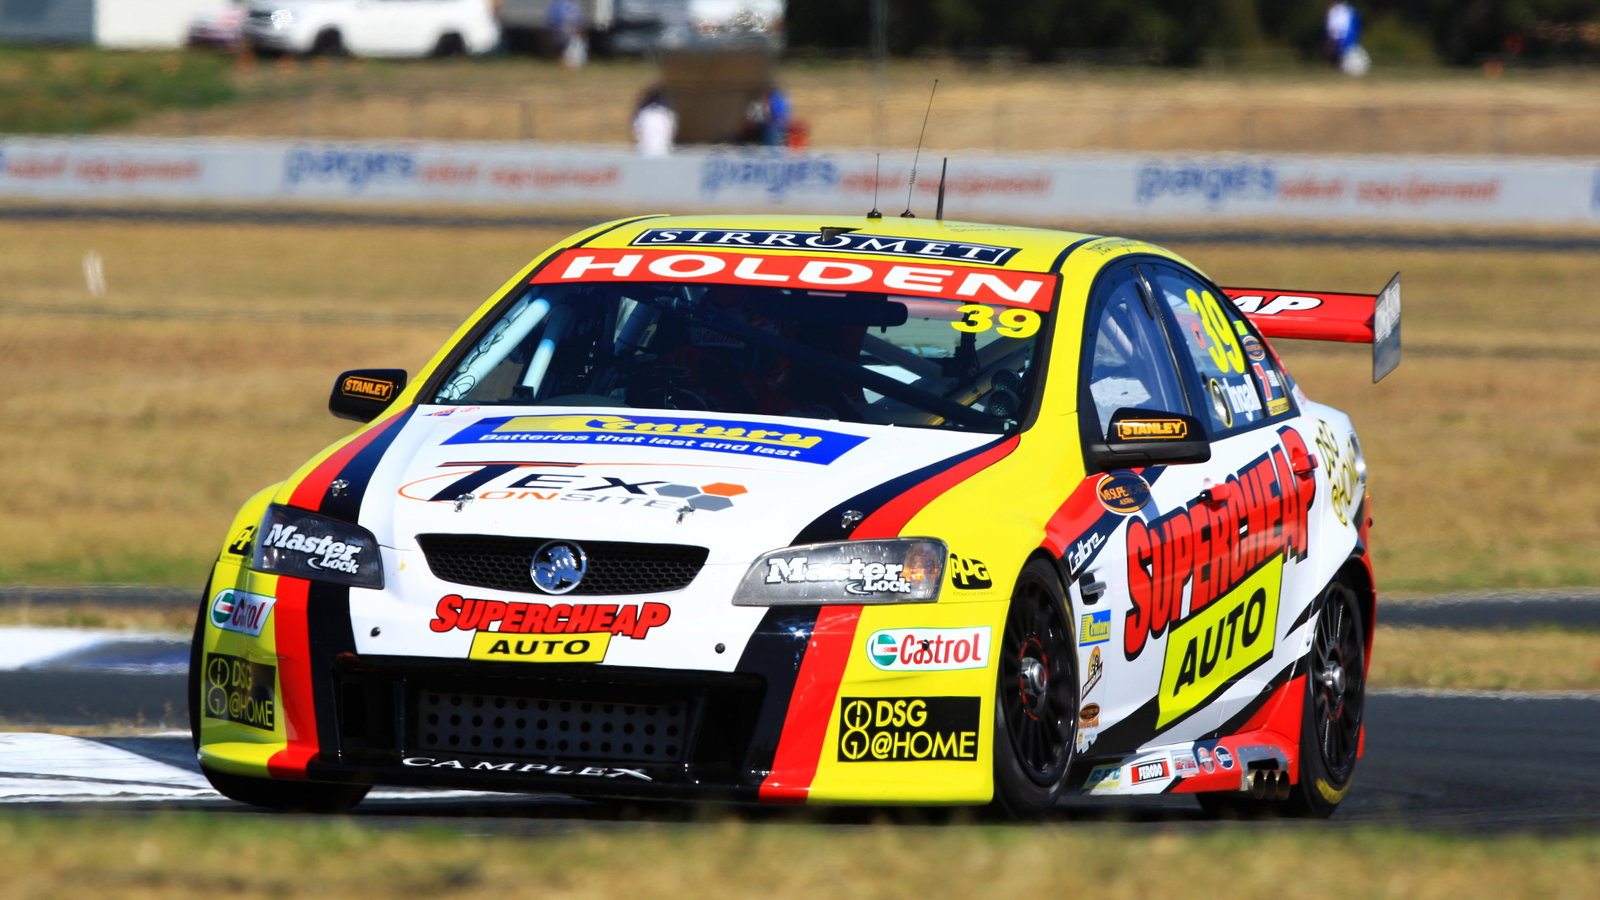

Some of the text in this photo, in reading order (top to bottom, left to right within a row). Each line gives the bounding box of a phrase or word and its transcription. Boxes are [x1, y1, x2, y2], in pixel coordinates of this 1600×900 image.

[1136, 162, 1277, 208] pages
[649, 229, 999, 260] SIRROMET
[561, 254, 1044, 304] HOLDEN
[950, 304, 1042, 338] 39
[1186, 289, 1245, 374] 39
[344, 379, 390, 397] STANLEY
[548, 415, 823, 449] Century
[1122, 422, 1181, 436] STANLEY
[478, 433, 801, 458] Batteries that last and last
[427, 461, 673, 502] TEX
[262, 523, 363, 561] Master
[1124, 425, 1317, 661] SUPERCHEAP
[319, 553, 360, 575] Lock
[764, 557, 904, 585] Master
[950, 557, 991, 585] PPG
[862, 578, 911, 593] Lock
[429, 594, 671, 640] SUPERCHEAP
[488, 639, 591, 656] AUTO
[900, 633, 982, 665] Castrol
[1173, 587, 1267, 698] AUTO
[232, 661, 253, 692] DSG
[229, 692, 273, 727] @HOME
[875, 700, 928, 728] DSG
[871, 731, 976, 760] @HOME
[402, 757, 652, 781] CAMPLEX
[1138, 763, 1163, 780] FERODO
